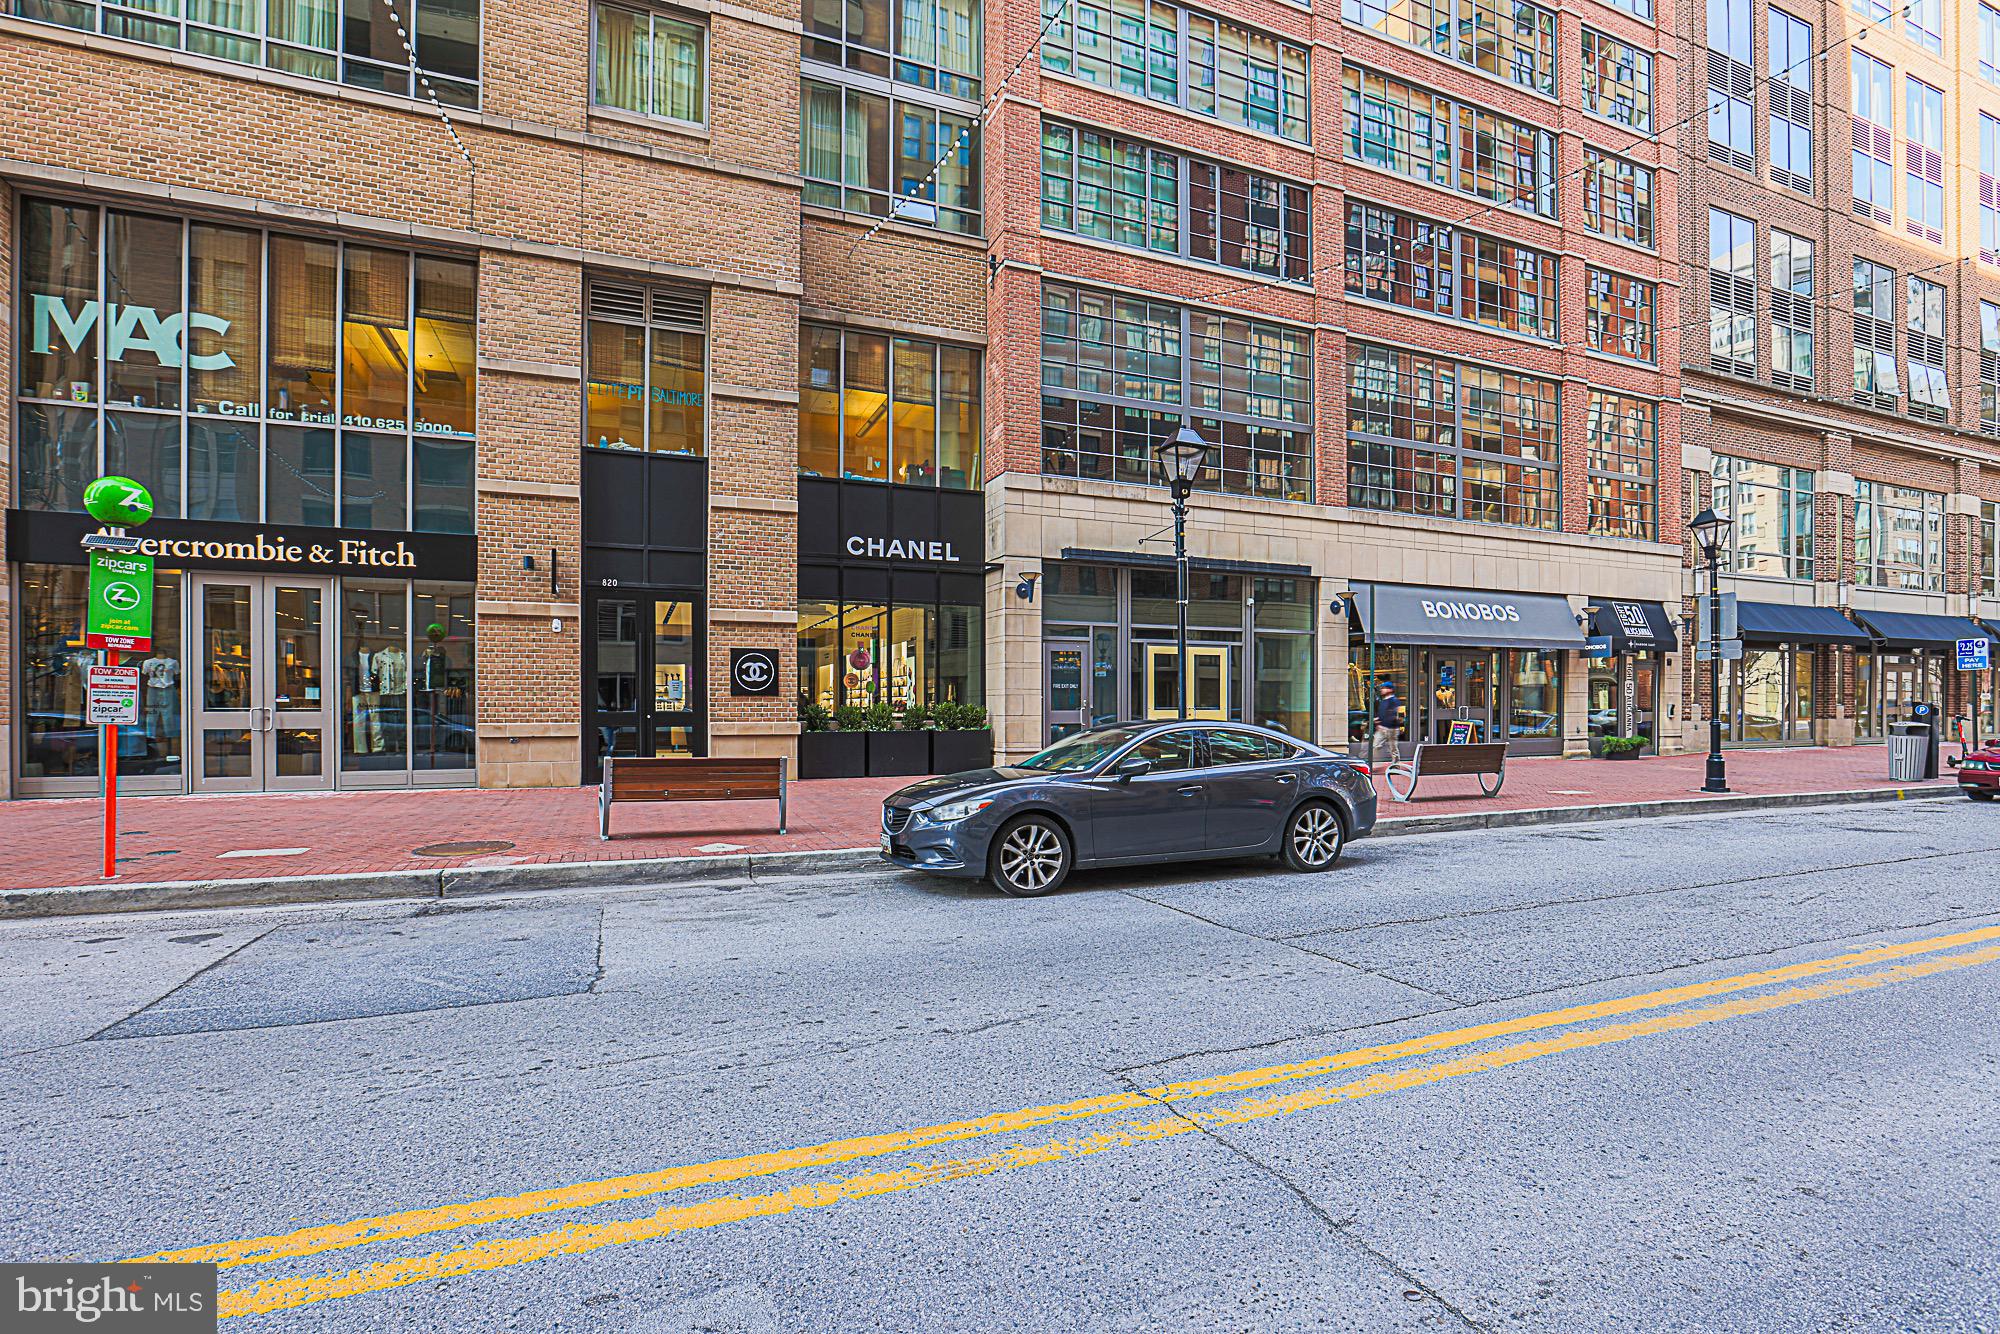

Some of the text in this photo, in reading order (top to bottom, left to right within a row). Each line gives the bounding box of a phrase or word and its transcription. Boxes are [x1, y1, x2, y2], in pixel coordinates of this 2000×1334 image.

[30, 293, 236, 371] MAC
[651, 385, 704, 407] BALTIMORE
[218, 400, 259, 417] Call
[269, 407, 293, 420] for
[301, 412, 335, 424] trial
[85, 527, 417, 568] ercrombie & Fitch
[846, 536, 960, 562] CHANEL
[97, 556, 147, 572] zipcars
[602, 578, 618, 587] 820
[1421, 600, 1521, 622] BONOBOS
[1624, 605, 1644, 624] 50
[101, 623, 139, 631] zipcar.com
[119, 637, 135, 645] ZONE
[114, 668, 135, 676] ZONE
[92, 704, 124, 714] zipcar
